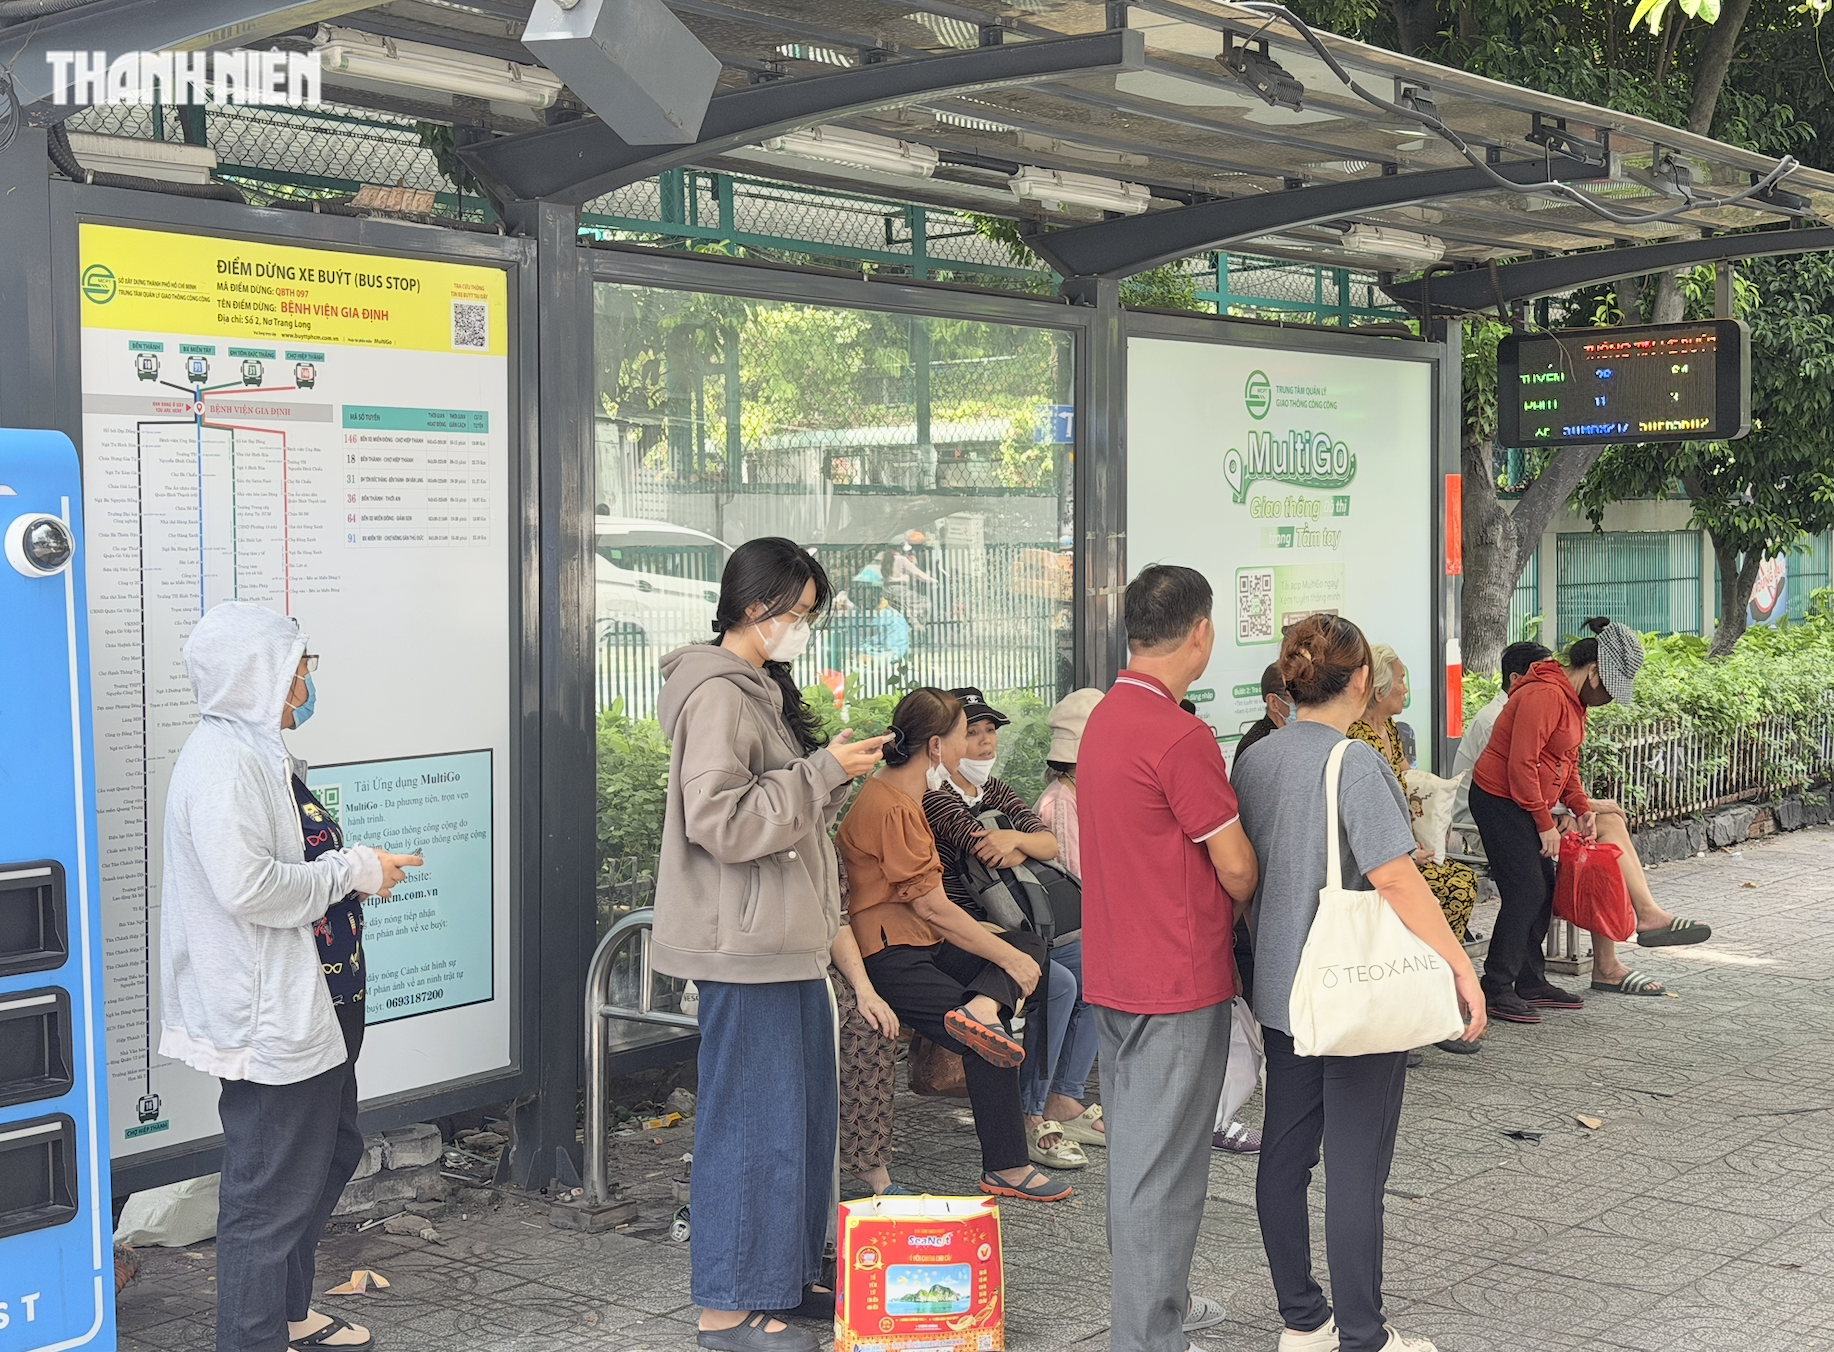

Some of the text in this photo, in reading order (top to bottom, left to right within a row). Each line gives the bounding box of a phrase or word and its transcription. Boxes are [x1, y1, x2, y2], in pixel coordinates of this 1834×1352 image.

[217, 256, 421, 294] ĐIỂM DỪNG XE BUÝT (BUS STOP)
[119, 289, 133, 297] TRUNG
[161, 292, 172, 300] GIAO
[217, 281, 309, 298] MÃ ĐIỂM DỪNG: QBTH 097
[217, 298, 389, 323] TÊN ĐIỂM DỪNG: BỆNH VIỆN GIA ĐỊNH
[217, 313, 312, 331] Địa chỉ: Số 2, Nơ Trang Long
[1276, 384, 1328, 396] TRUNG TÂM QUẢN LÝ
[210, 404, 291, 417] BỆNH VIỆN GIA ĐỊNH
[1276, 398, 1338, 411] GIAO THÔNG CÔNG CỘNG
[344, 434, 357, 443] 146
[346, 453, 356, 464] 18
[1248, 430, 1350, 479] MultiGo
[346, 474, 355, 484] 31
[347, 493, 356, 504] 36
[1250, 495, 1282, 519] Giao
[1283, 495, 1322, 522] thông
[1335, 498, 1347, 517] thị
[347, 513, 356, 523] 64
[347, 533, 356, 544] 91
[1296, 522, 1322, 548] Tầm
[1323, 526, 1342, 550] tay
[1291, 581, 1301, 591] app
[1302, 579, 1324, 590] MultiGo
[1280, 595, 1293, 605] Xem
[354, 771, 461, 793] Tải Ứng dụng MultiGo
[345, 792, 469, 813] MultiGo Đa phương tiện, trọn vẹn
[347, 815, 365, 827] hành
[345, 819, 468, 843] Ứng dụng Giao thông công cộng do
[384, 839, 404, 852] Quản
[405, 838, 412, 848] lý
[413, 837, 431, 847] Giao
[432, 834, 451, 845] thông
[452, 831, 469, 843] công
[470, 829, 487, 841] cộng
[369, 908, 436, 927] dây nóng tiếp nhận
[365, 931, 375, 941] tin
[395, 925, 409, 936] ánh
[420, 923, 429, 932] xe
[430, 919, 448, 931] buýt:
[366, 972, 380, 983] dây
[381, 969, 399, 979] nóng
[400, 965, 419, 976] Cảnh
[420, 962, 430, 972] sát
[448, 959, 457, 968] sự
[1343, 955, 1440, 984] TEOXANE
[392, 980, 405, 990] ánh
[416, 978, 426, 986] an
[426, 974, 442, 985] ninh
[443, 971, 455, 982] trật
[456, 970, 464, 979] tự
[366, 1003, 385, 1014] buýt:
[386, 988, 444, 1009] 0693187200
[907, 1232, 952, 1247] SeaNest
